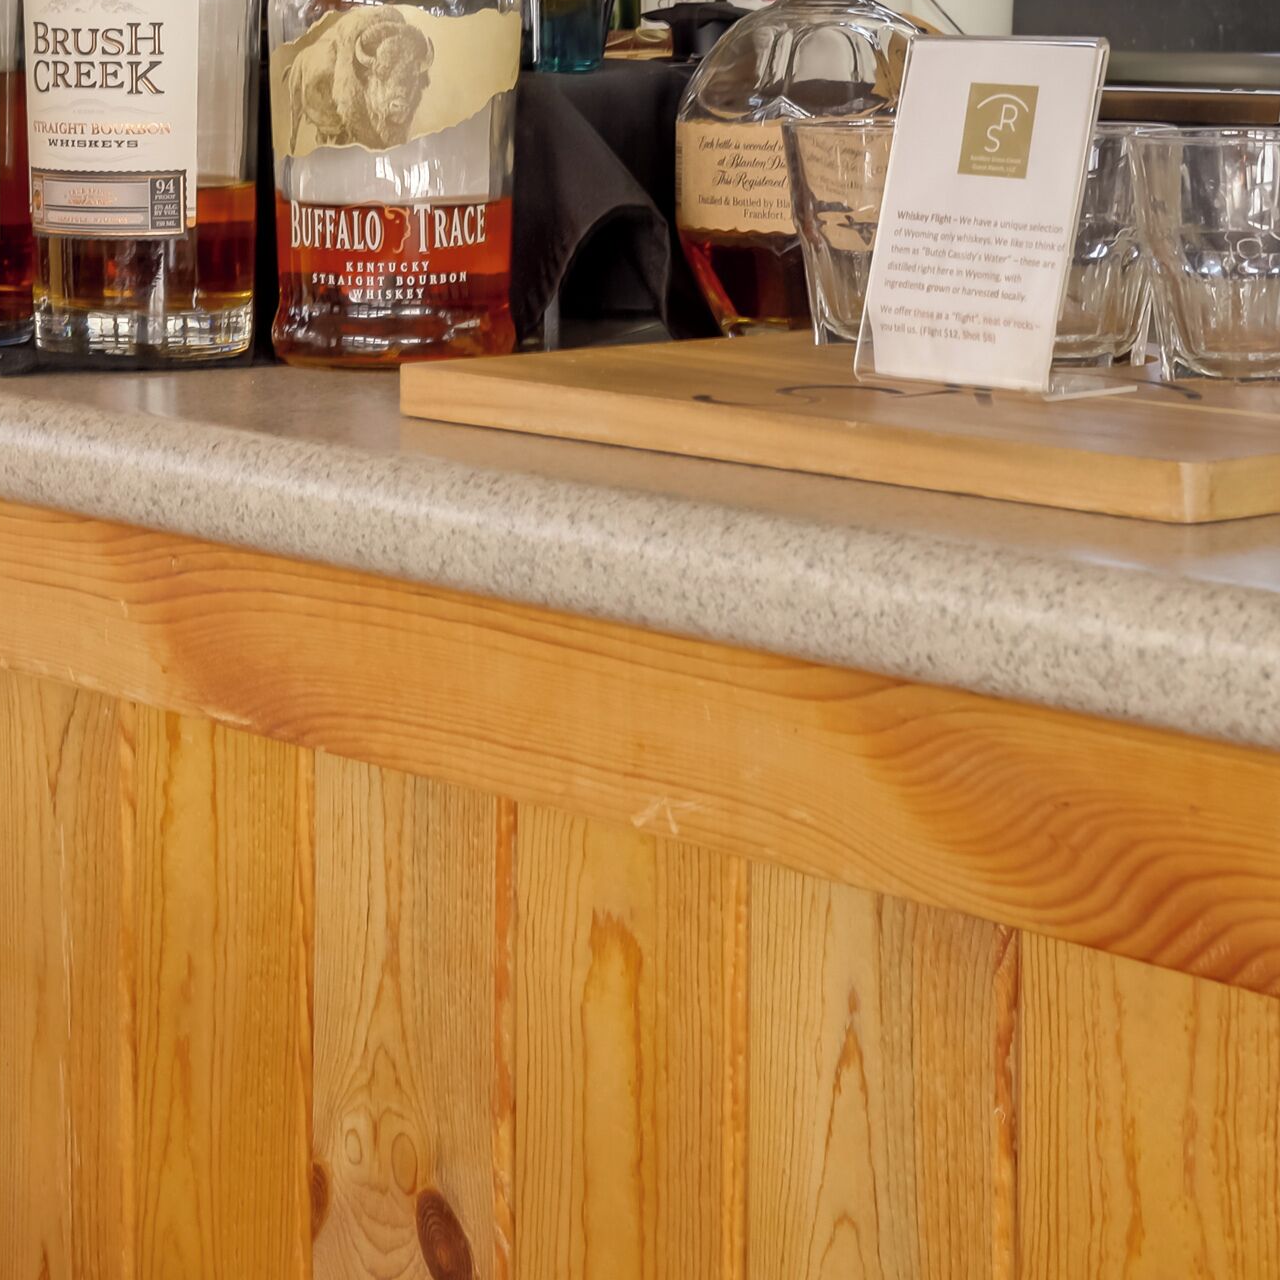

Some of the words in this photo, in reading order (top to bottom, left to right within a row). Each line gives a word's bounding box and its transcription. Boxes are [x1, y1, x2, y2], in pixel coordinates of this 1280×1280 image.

[33, 21, 165, 56] BRUSH
[33, 59, 166, 95] CREEK
[33, 121, 87, 135] STRAIGHT
[91, 122, 172, 135] BOURBON
[47, 138, 139, 149] WHISKEYS
[155, 178, 176, 194] 94
[712, 170, 733, 186] This
[733, 172, 787, 192] Registered
[698, 194, 723, 206] Distilled
[723, 198, 730, 206] &
[732, 197, 761, 207] Bottled
[763, 198, 773, 209] by
[290, 200, 383, 252] BUFFALO
[413, 204, 487, 254] TRACE
[897, 210, 930, 223] Whiskey
[930, 213, 952, 225] Flight
[959, 215, 971, 225] We
[973, 216, 993, 227] have
[999, 221, 1028, 232] unique
[1028, 223, 1064, 234] selection
[894, 228, 903, 237] of
[904, 228, 940, 242] Wyoming
[940, 232, 956, 243] only
[994, 236, 1008, 246] We
[1010, 238, 1024, 248] like
[1025, 241, 1034, 249] to
[1034, 241, 1056, 251] think
[1056, 242, 1066, 252] of
[345, 261, 430, 273] KENTUCKY
[891, 244, 911, 255] them
[911, 247, 919, 255] as
[1019, 256, 1041, 268] these
[1042, 261, 1056, 270] are
[312, 271, 385, 287] STRAIGHT
[396, 271, 468, 287] BOURBON
[887, 261, 917, 273] distilled
[917, 264, 936, 275] right
[936, 267, 954, 276] here
[965, 269, 1002, 283] Wyoming,
[1003, 273, 1023, 283] with
[351, 287, 425, 301] WHISKEY
[883, 277, 925, 291] ingredients
[925, 283, 951, 294] grown
[951, 286, 961, 295] or
[961, 286, 1001, 299] harvested
[880, 304, 893, 314] We
[894, 305, 912, 316] offer
[913, 307, 935, 319] these
[935, 311, 943, 320] as
[982, 316, 1001, 326] neat
[1002, 319, 1012, 327] or
[1013, 320, 1035, 331] rocks
[879, 323, 893, 333] you
[894, 324, 906, 333] tell
[906, 326, 918, 334] us.
[919, 325, 942, 338] (Flight
[962, 330, 981, 341] Shot
